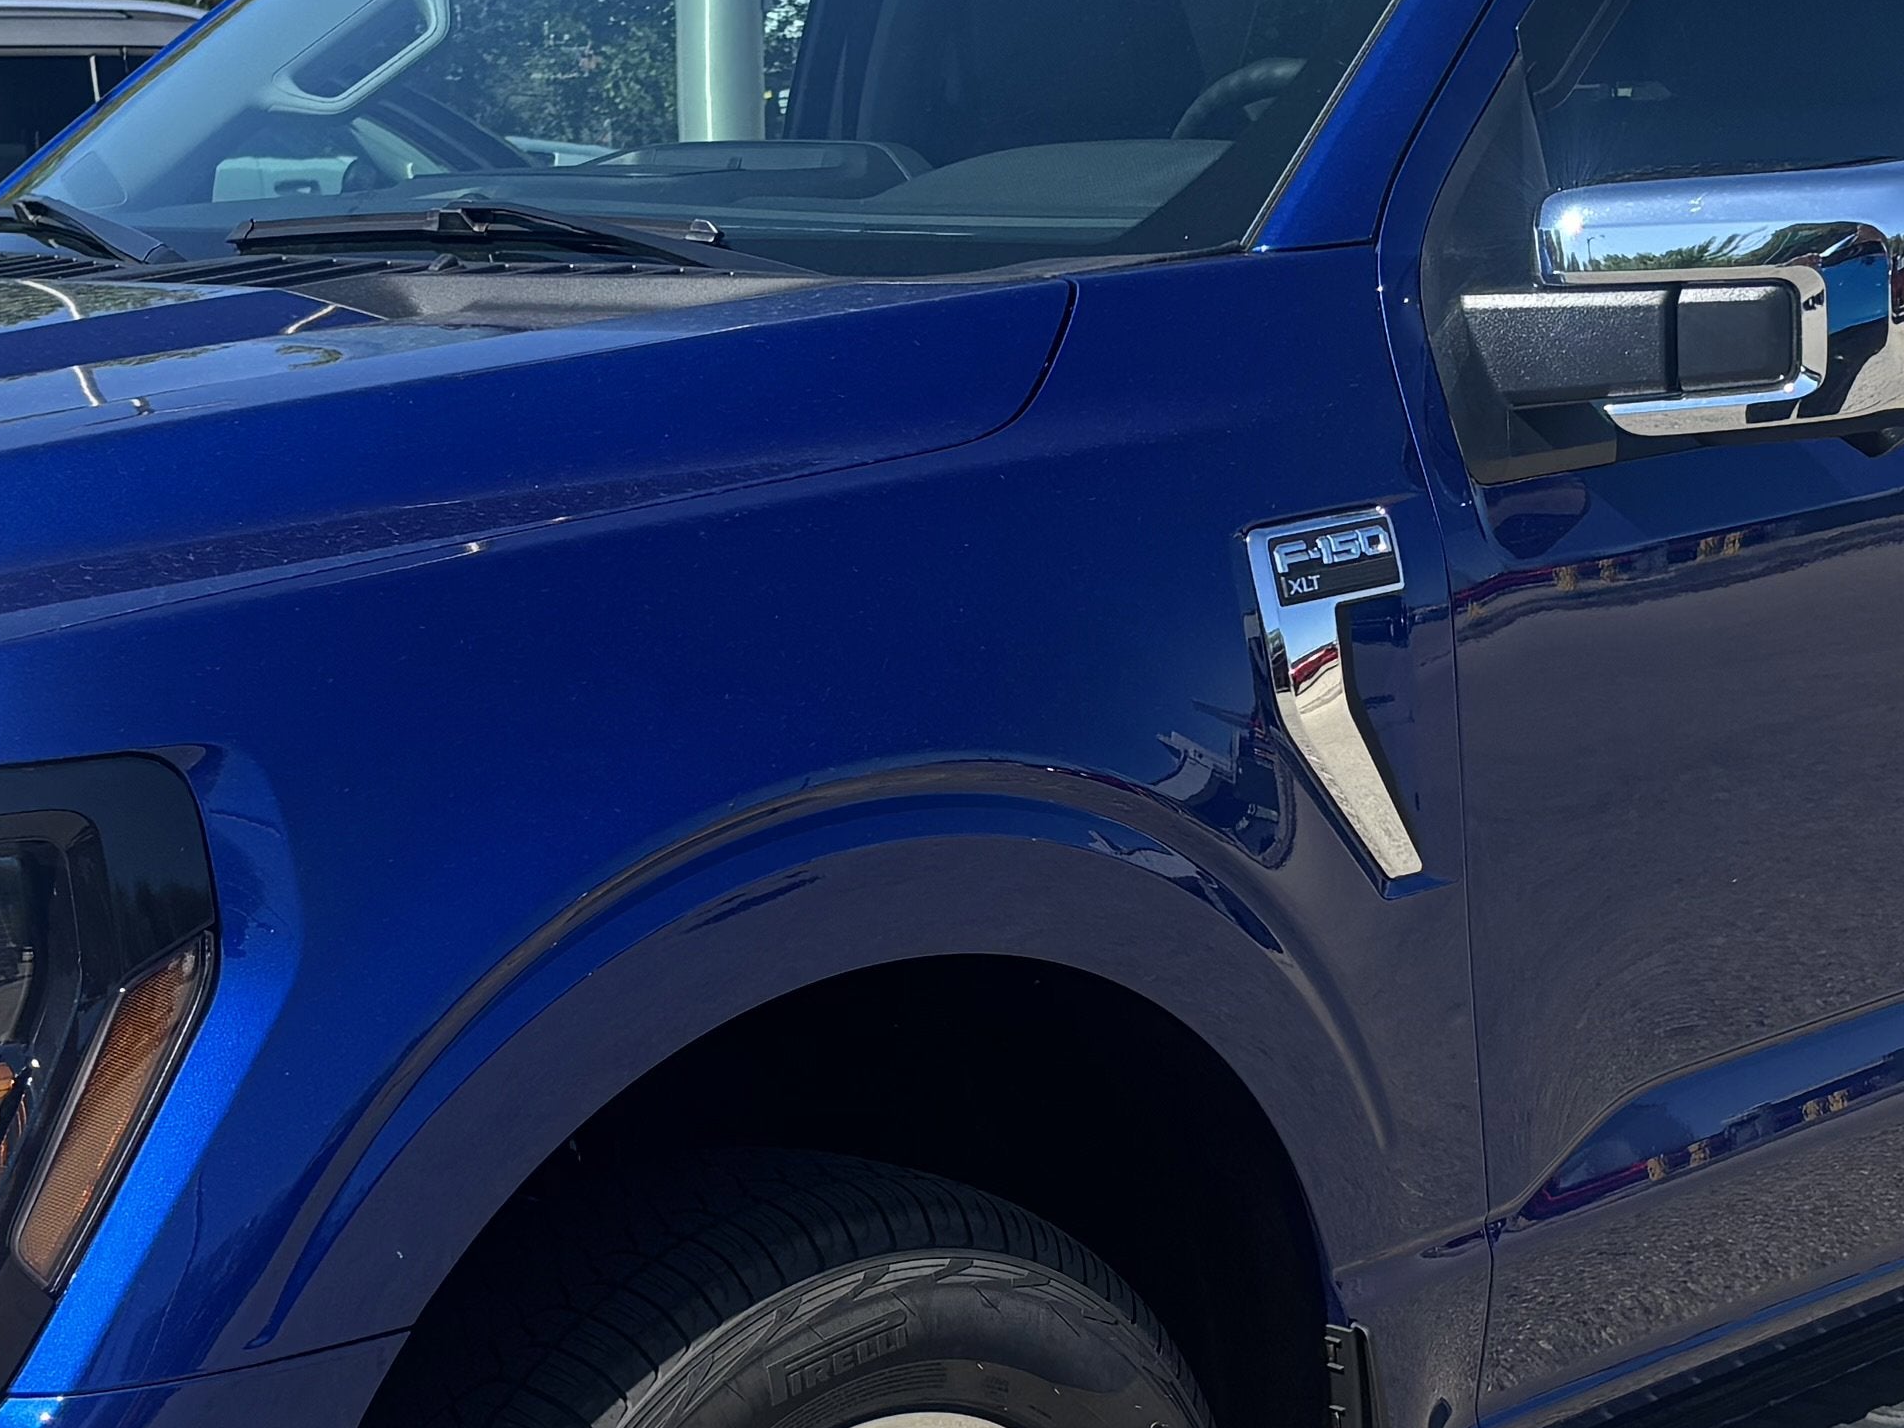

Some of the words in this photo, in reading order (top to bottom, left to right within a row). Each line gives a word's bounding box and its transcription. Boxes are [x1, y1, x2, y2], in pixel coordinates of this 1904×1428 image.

[1273, 524, 1392, 574] F-150
[1287, 574, 1321, 597] XLT
[767, 1308, 911, 1406] PIRELLI
